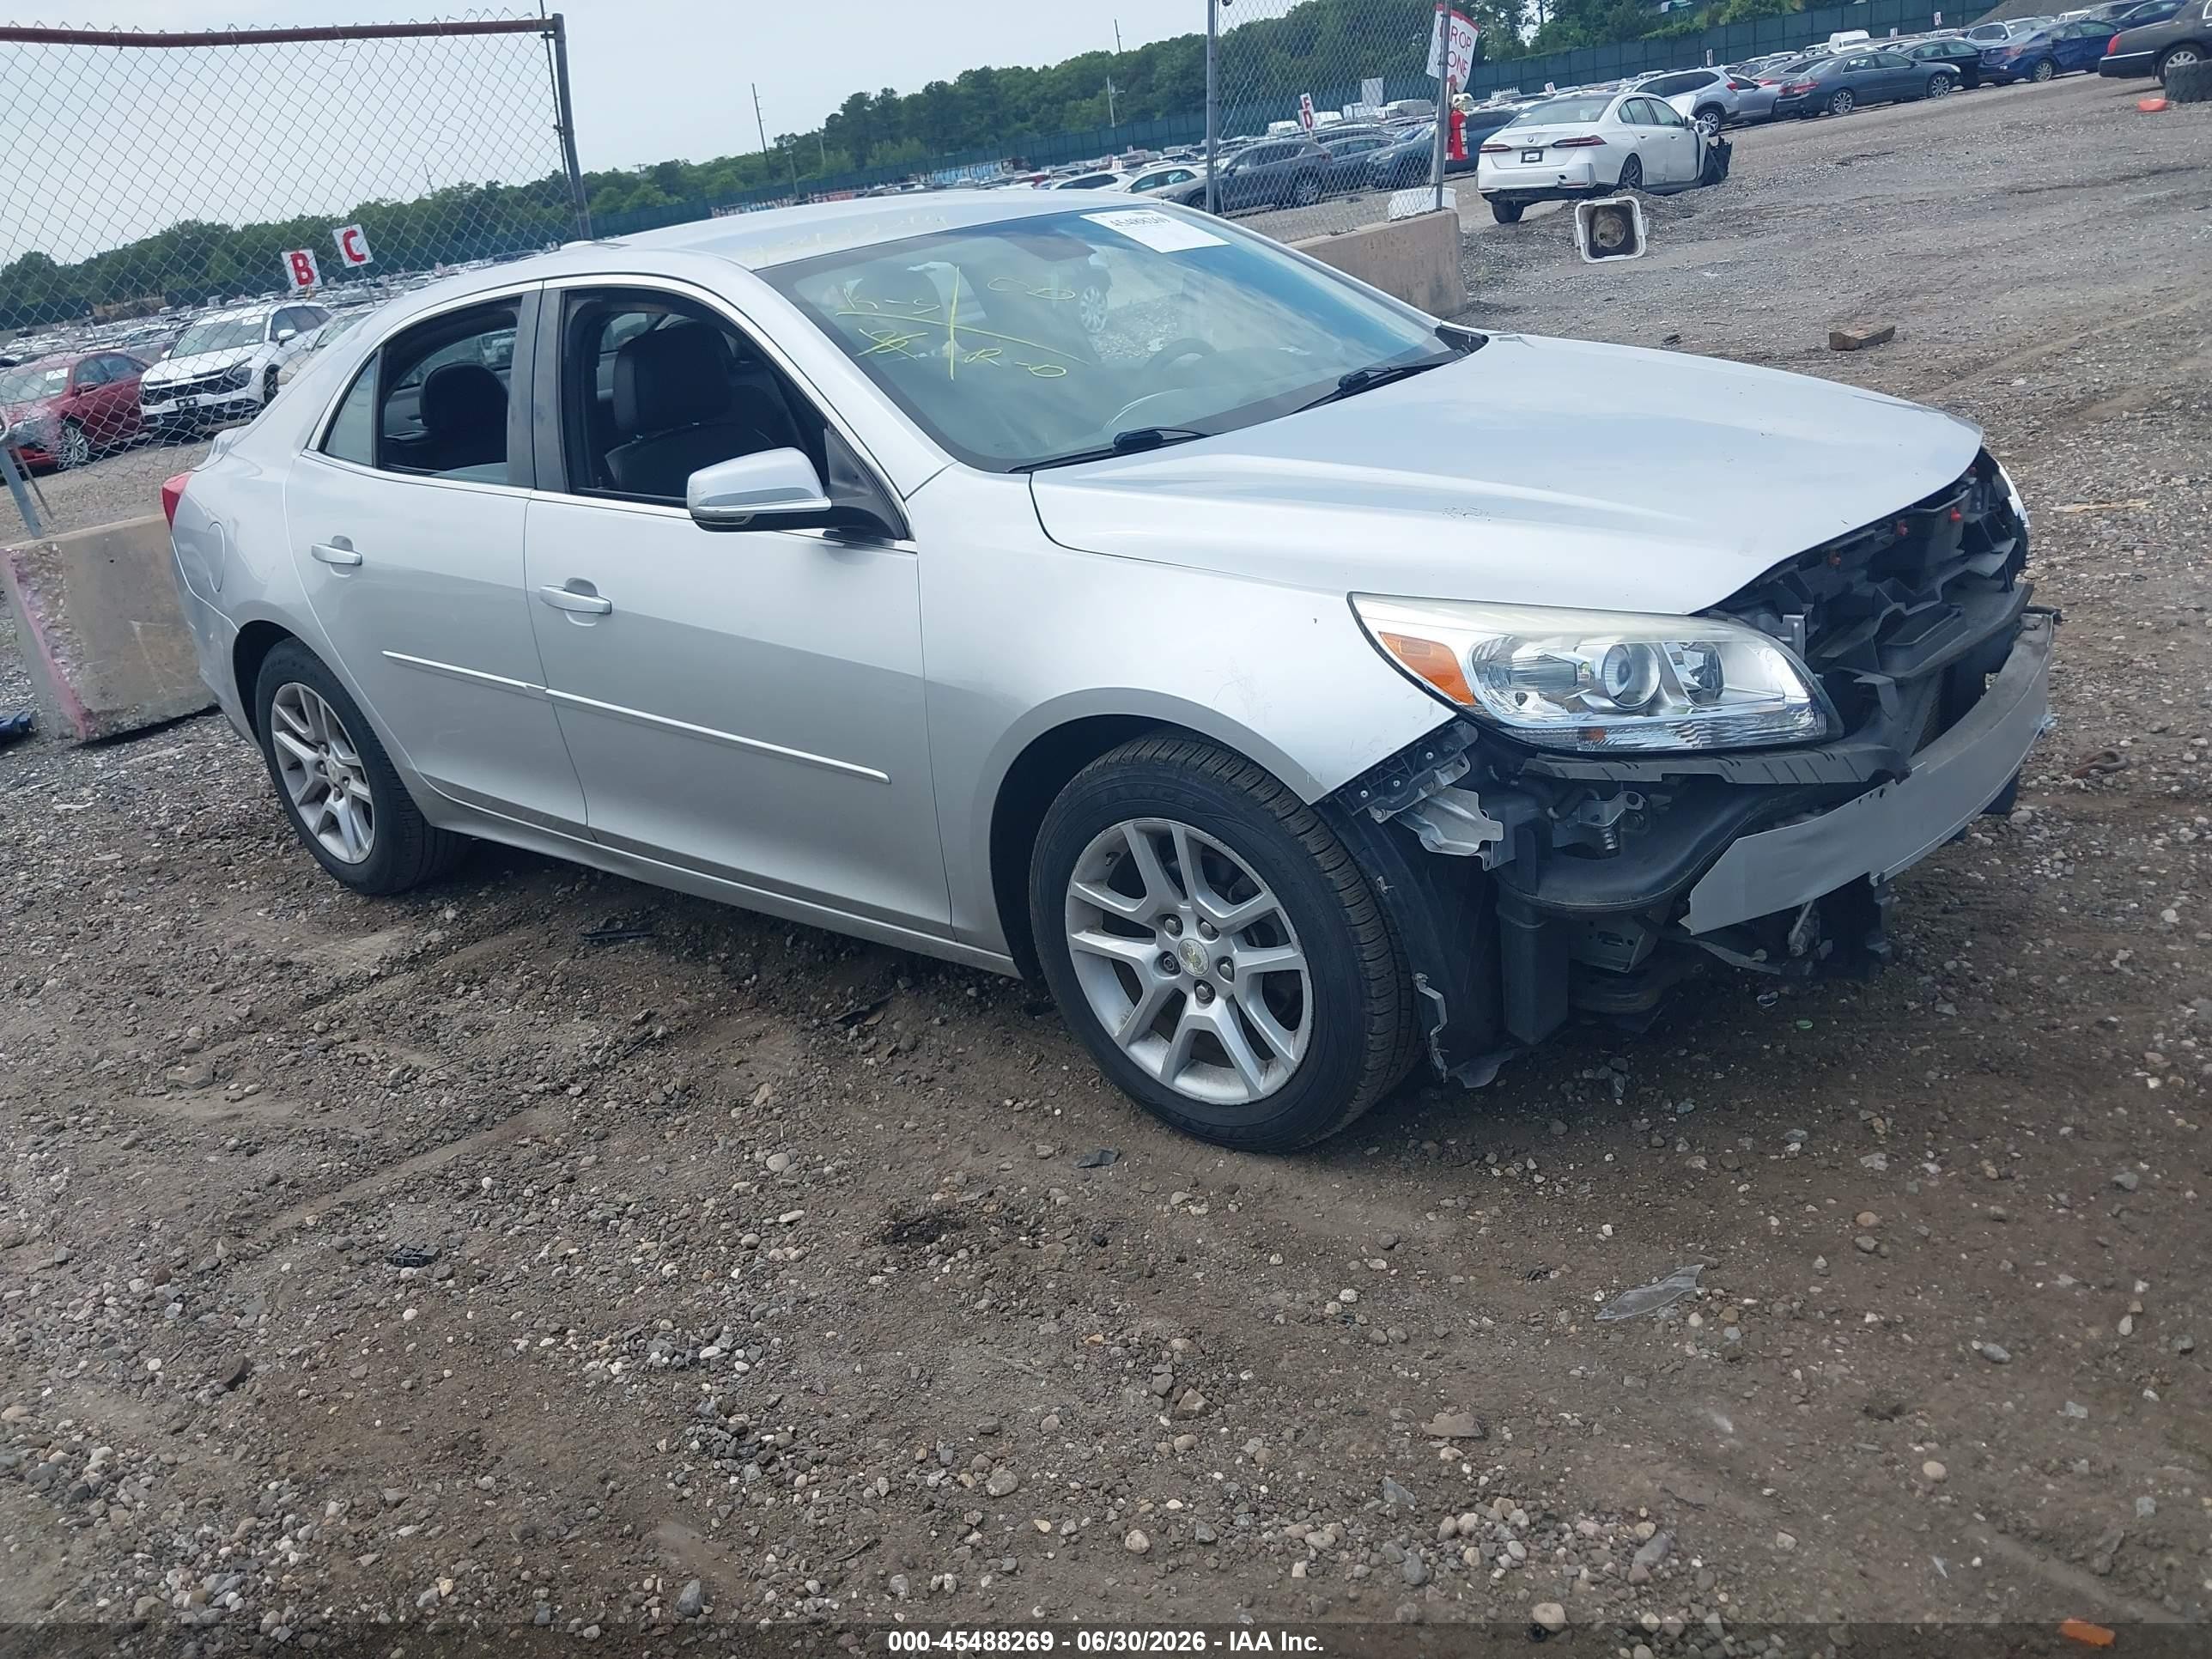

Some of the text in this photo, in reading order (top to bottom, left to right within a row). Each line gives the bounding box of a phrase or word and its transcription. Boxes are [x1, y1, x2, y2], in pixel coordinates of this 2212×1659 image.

[1443, 22, 1472, 52] ROP
[1443, 51, 1469, 79] ONE
[343, 229, 367, 262] C
[290, 252, 315, 286] B
